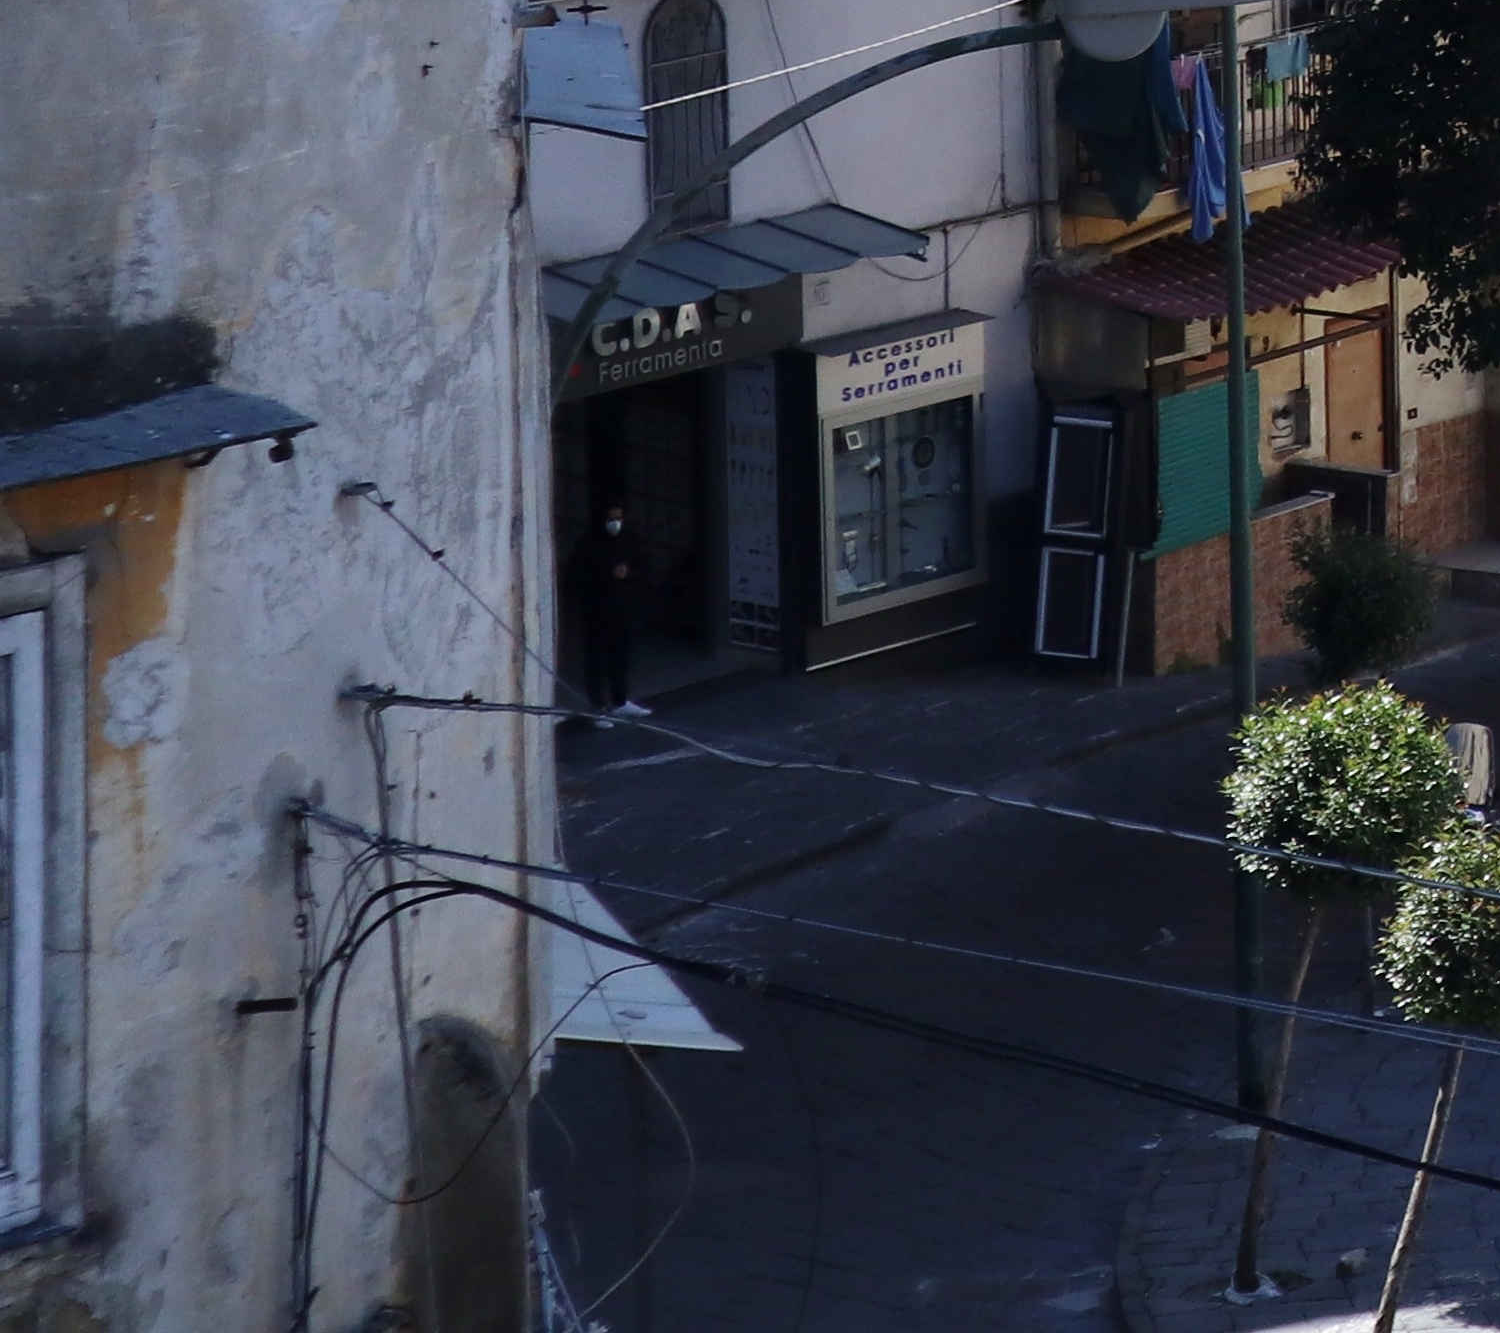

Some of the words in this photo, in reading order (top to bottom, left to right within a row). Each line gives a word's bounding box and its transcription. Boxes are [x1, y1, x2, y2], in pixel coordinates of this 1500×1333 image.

[600, 339, 722, 383] Ferramenta
[848, 328, 954, 367] Accessori
[884, 356, 920, 377] per
[842, 360, 962, 402] Serramenti
